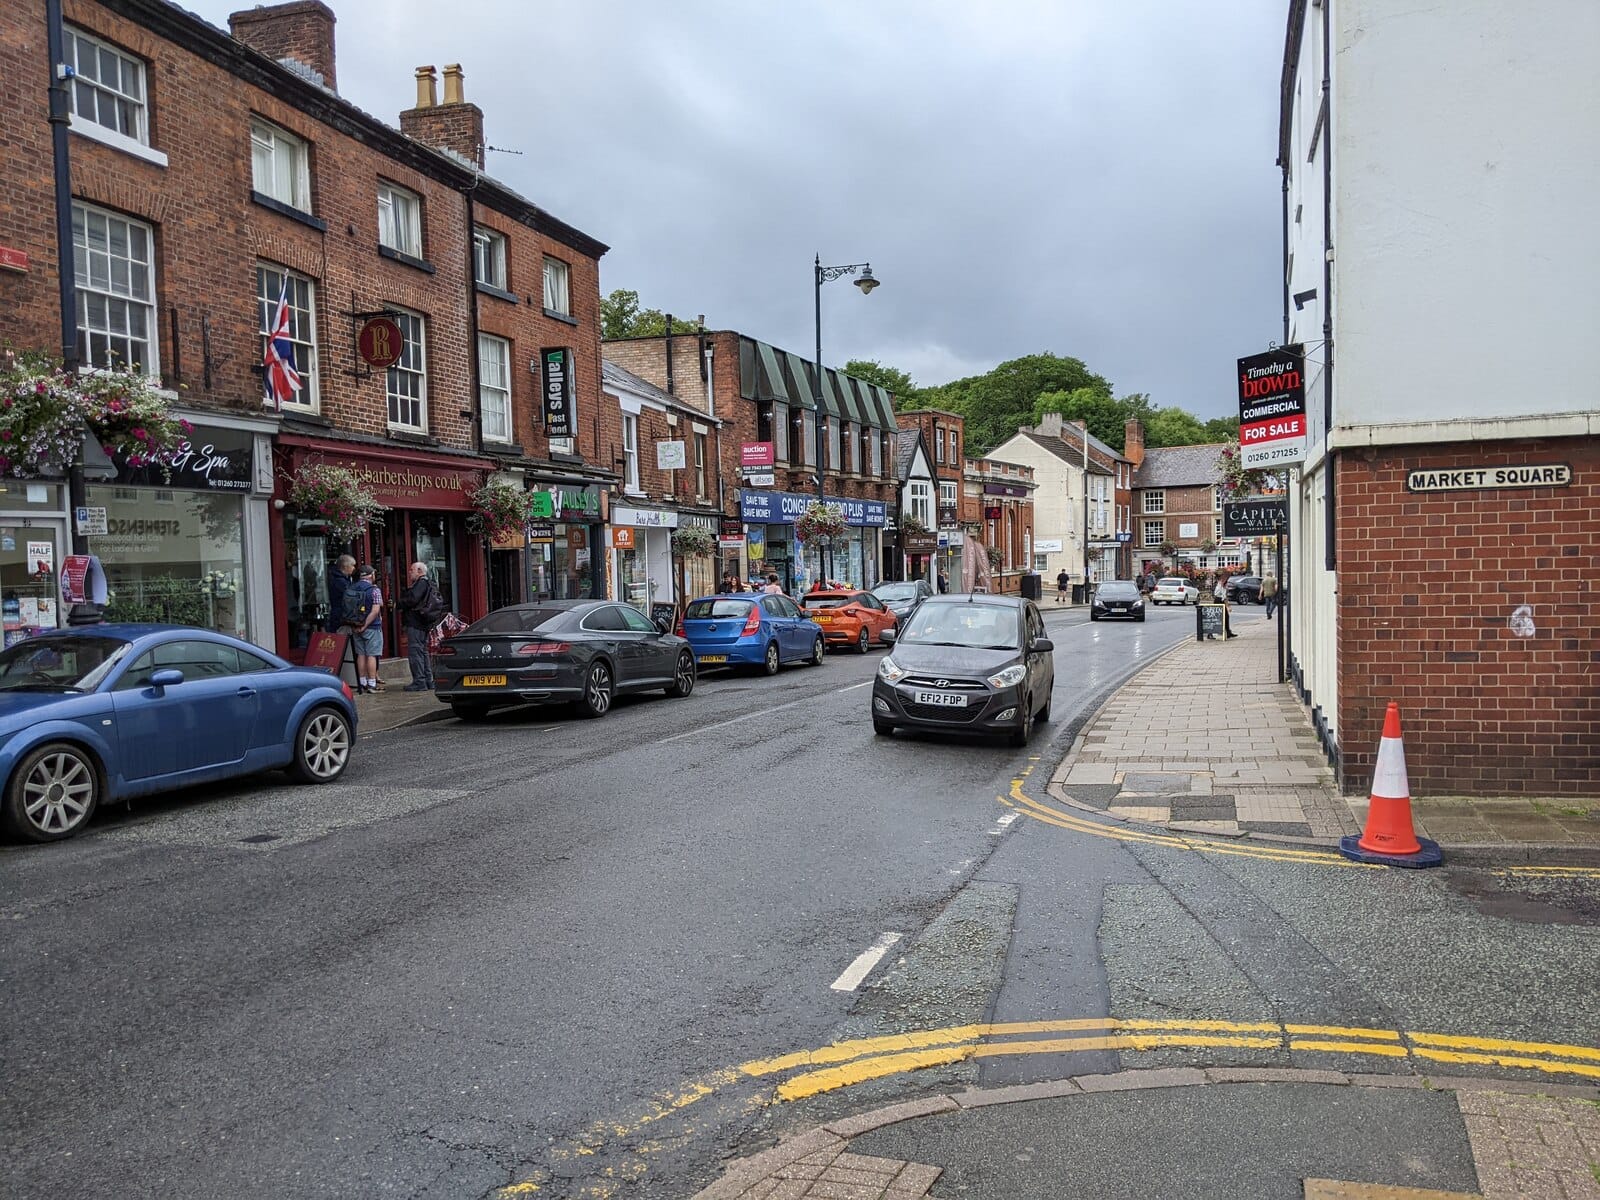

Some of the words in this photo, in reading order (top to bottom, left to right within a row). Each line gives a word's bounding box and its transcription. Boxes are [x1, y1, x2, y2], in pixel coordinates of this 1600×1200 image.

[1247, 361, 1285, 379] Timothy
[1286, 361, 1293, 370] a
[547, 351, 564, 410] Valleys
[1241, 371, 1301, 398] brown
[547, 413, 566, 423] Fast
[1243, 400, 1300, 419] COMMERCIAL
[1245, 426, 1267, 440] FOR
[1270, 421, 1299, 436] SALE
[743, 445, 767, 453] auction
[1248, 452, 1269, 462] 01260
[1271, 447, 1298, 459] 271255
[192, 444, 230, 479] Spa
[217, 479, 233, 487] 01260
[349, 464, 432, 492] ersbarbershops
[434, 473, 462, 490] co.uk
[1412, 471, 1487, 488] MARKET
[1495, 468, 1567, 483] SQUARE
[848, 502, 864, 517] PLUS
[29, 547, 51, 555] HALF
[920, 693, 941, 703] EF12
[943, 695, 962, 705] FDP
